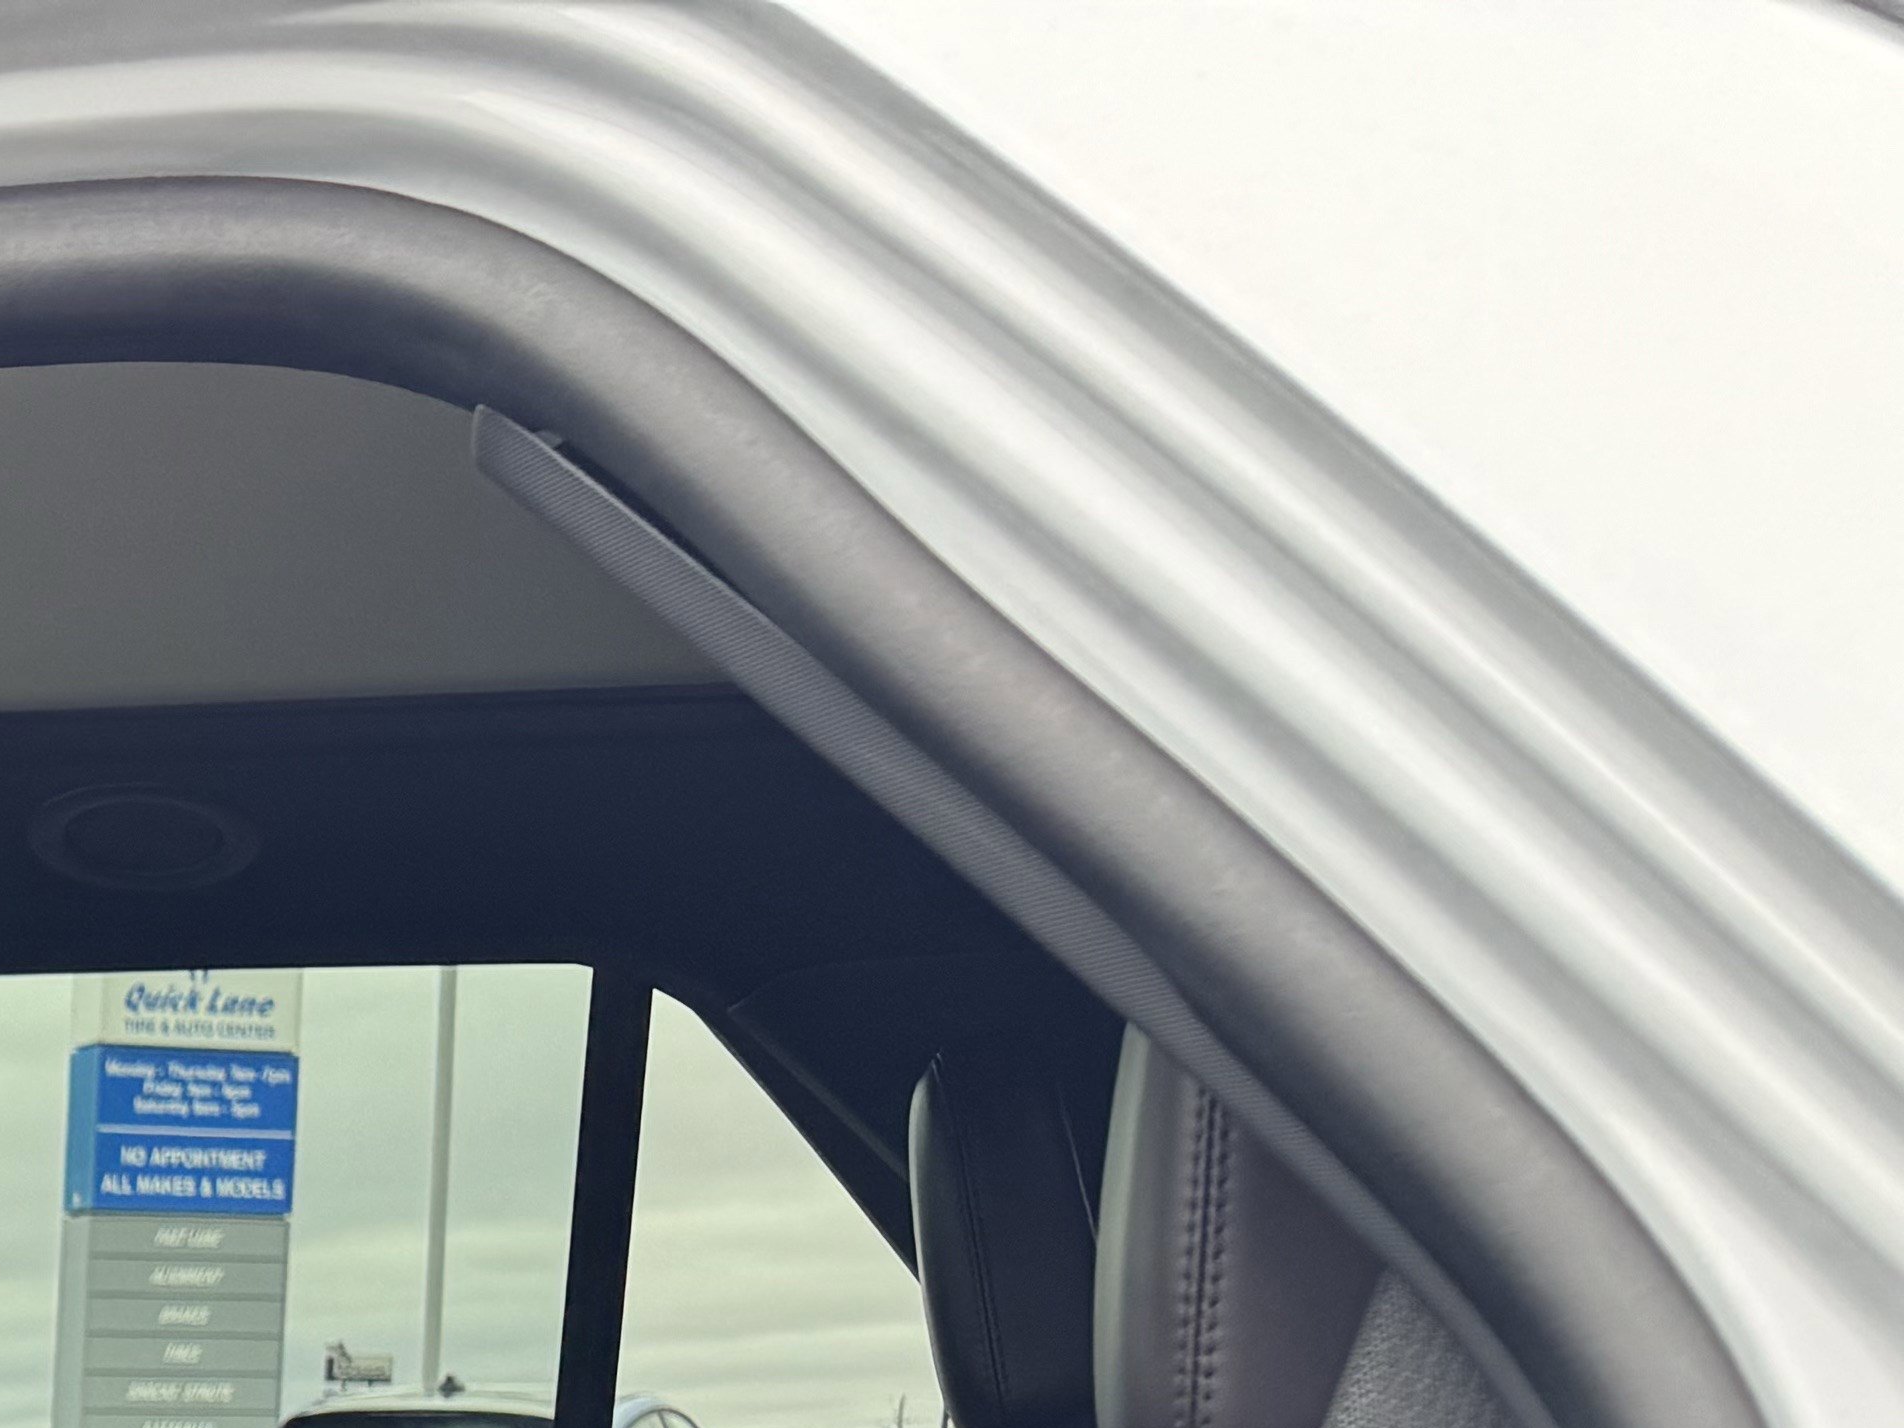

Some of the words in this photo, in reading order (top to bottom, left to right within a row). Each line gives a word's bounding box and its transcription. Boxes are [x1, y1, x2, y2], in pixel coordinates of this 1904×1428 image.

[124, 982, 200, 1014] Quick
[205, 986, 275, 1018] Lane
[125, 1018, 155, 1035] TIRE
[173, 1019, 213, 1037] AUTO
[217, 1020, 276, 1040] CENTER
[105, 1057, 156, 1079] Monday
[168, 1060, 226, 1083] Thursday
[143, 1078, 182, 1099] Friday
[133, 1097, 189, 1118] Saturday
[120, 1146, 146, 1167] NO
[149, 1146, 266, 1170] APPOINTMENT
[100, 1173, 132, 1195] ALL
[136, 1175, 196, 1197] MAKES
[216, 1177, 285, 1200] MODELS
